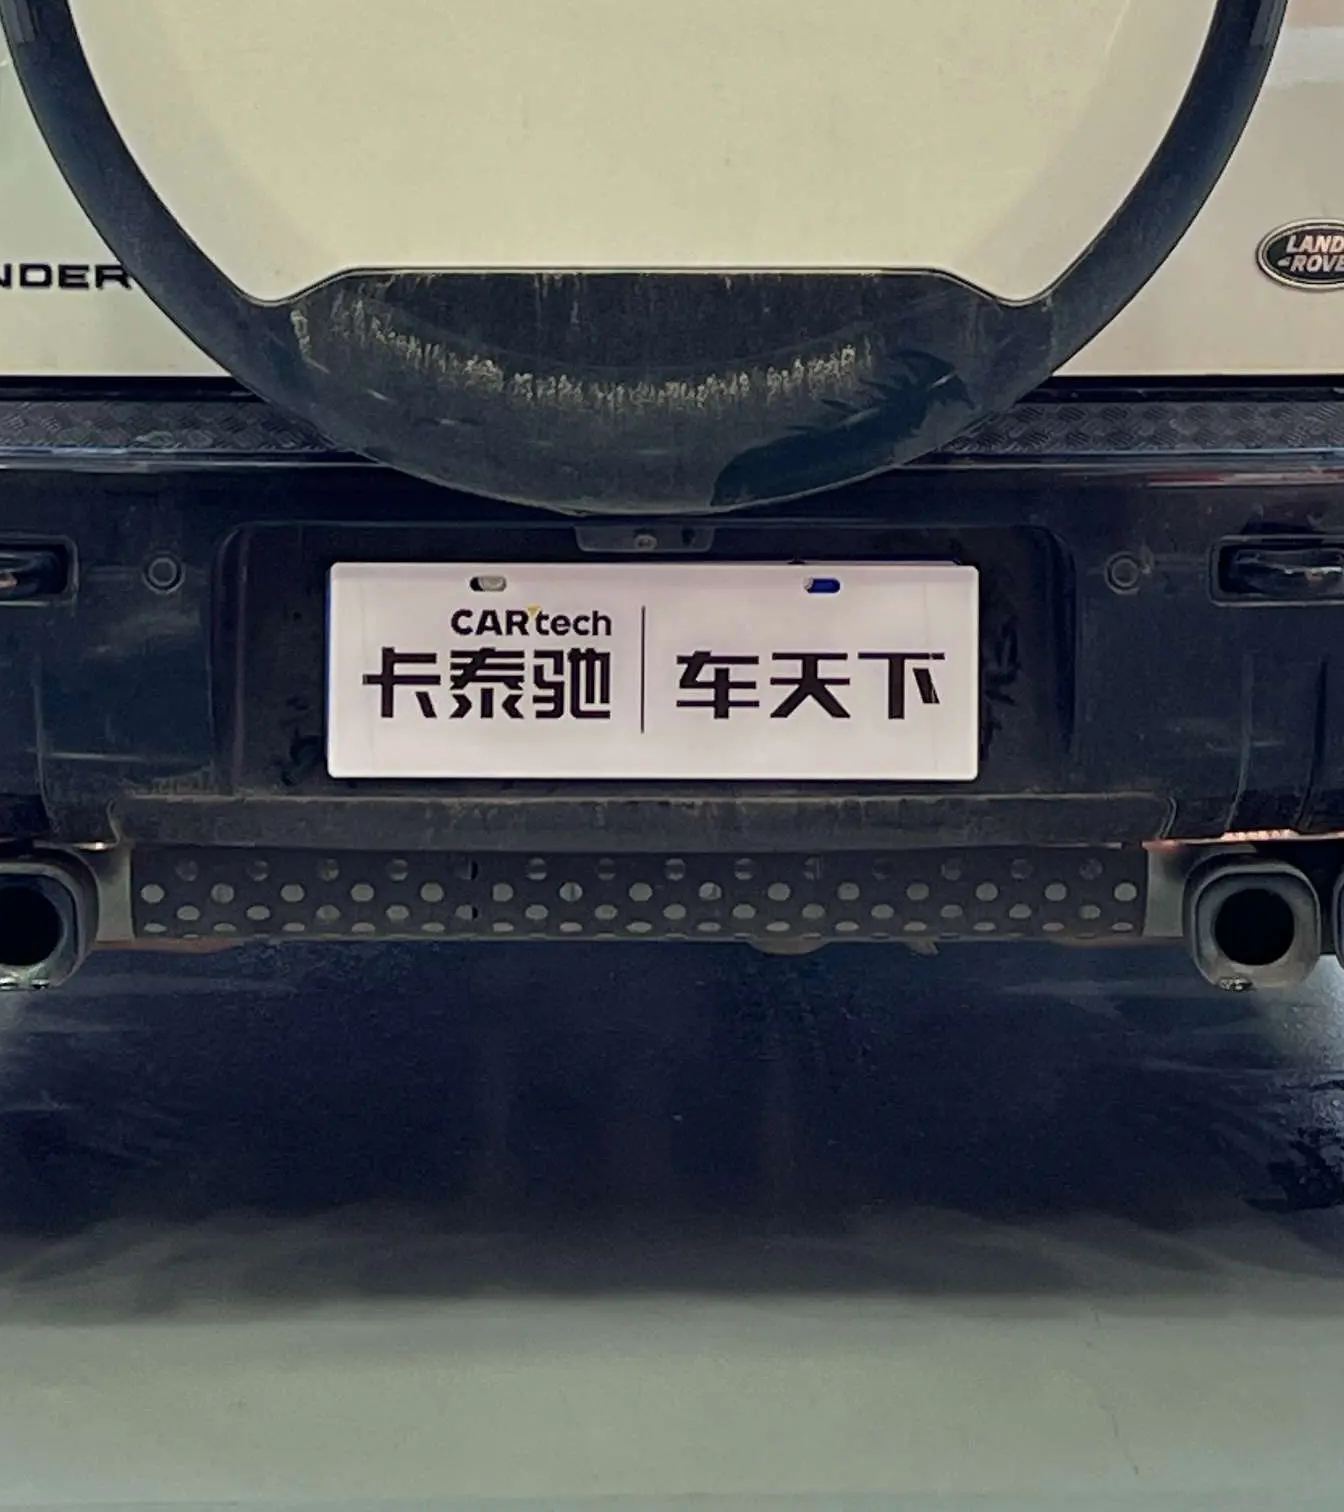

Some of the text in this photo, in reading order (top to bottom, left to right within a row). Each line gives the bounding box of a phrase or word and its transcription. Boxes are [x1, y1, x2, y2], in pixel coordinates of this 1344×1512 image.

[449, 606, 613, 638] CARtech
[361, 645, 946, 720] 卡泰驰 车天下
